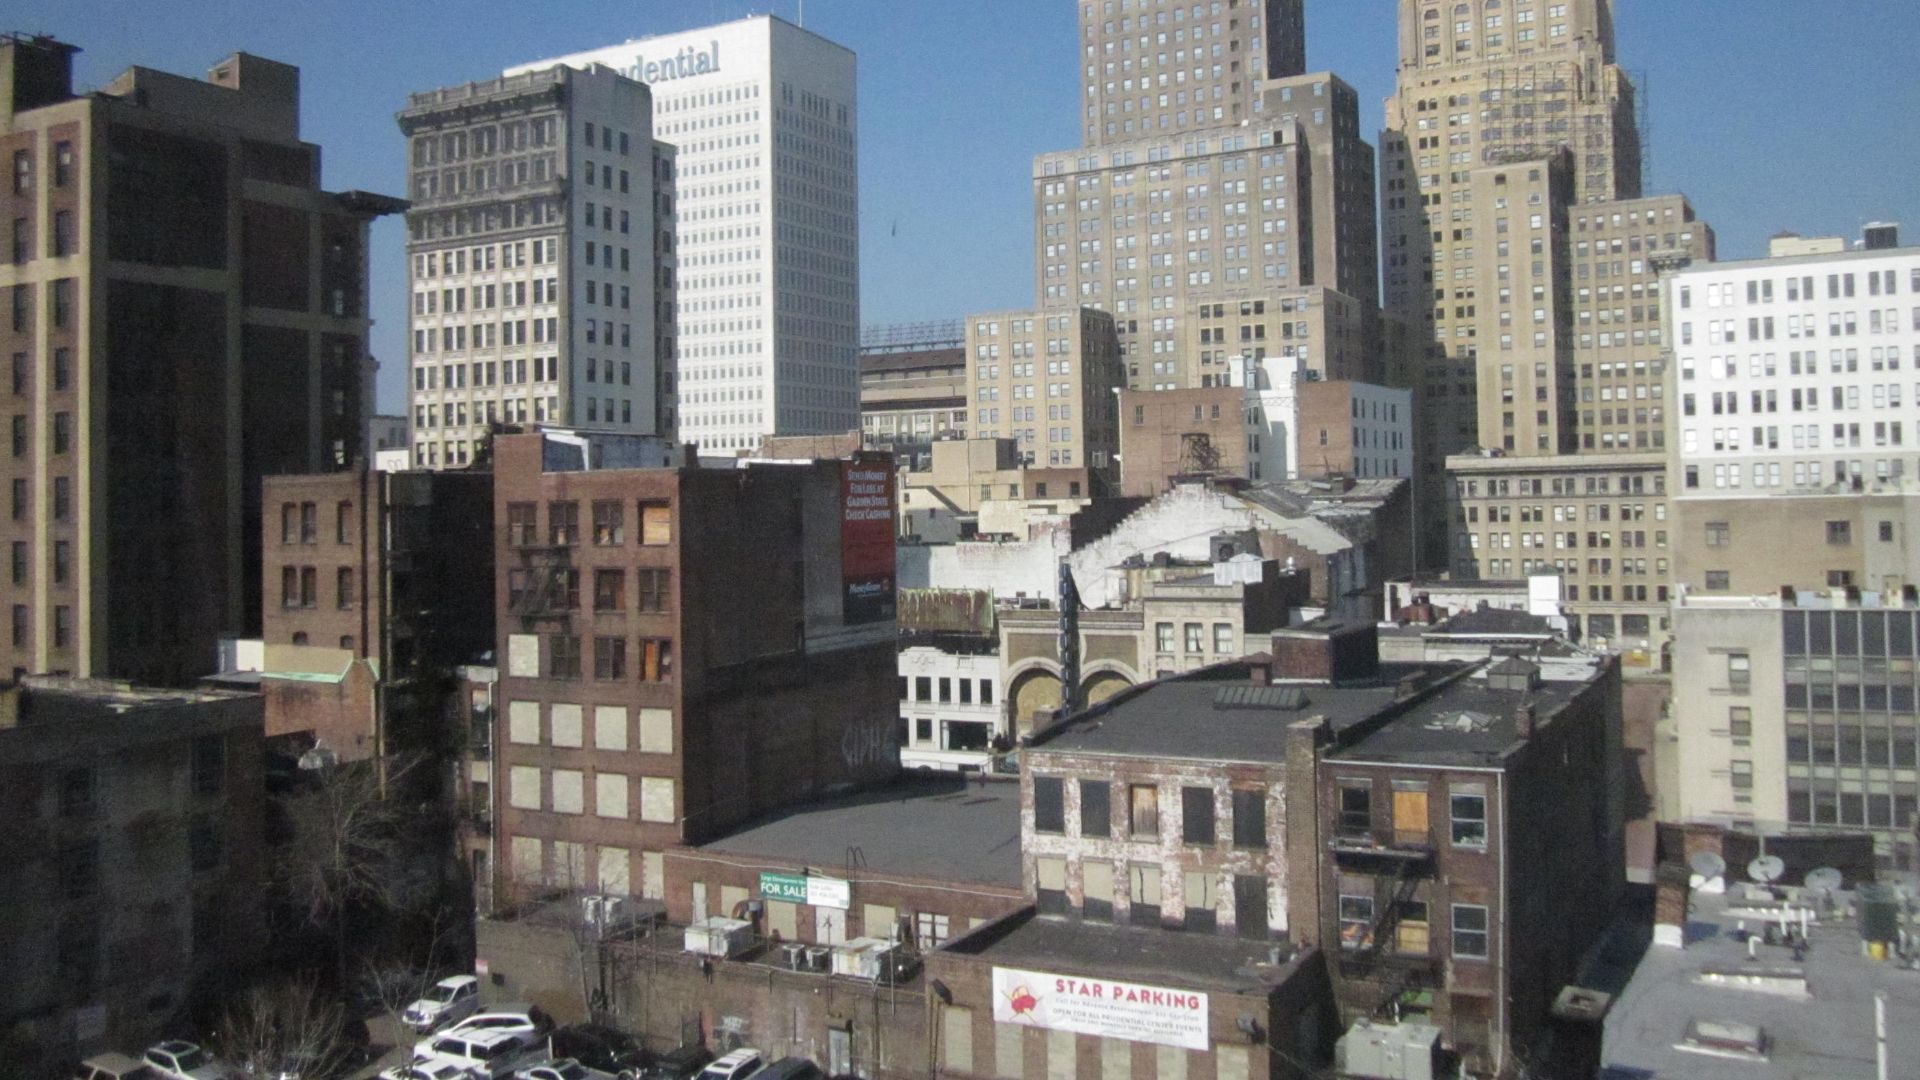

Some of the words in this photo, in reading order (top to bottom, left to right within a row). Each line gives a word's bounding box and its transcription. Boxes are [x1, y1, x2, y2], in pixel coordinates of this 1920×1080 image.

[761, 882, 781, 895] FOR
[783, 884, 807, 898] SALE
[1055, 978, 1103, 998] STAR
[1113, 985, 1200, 1010] PARKING
